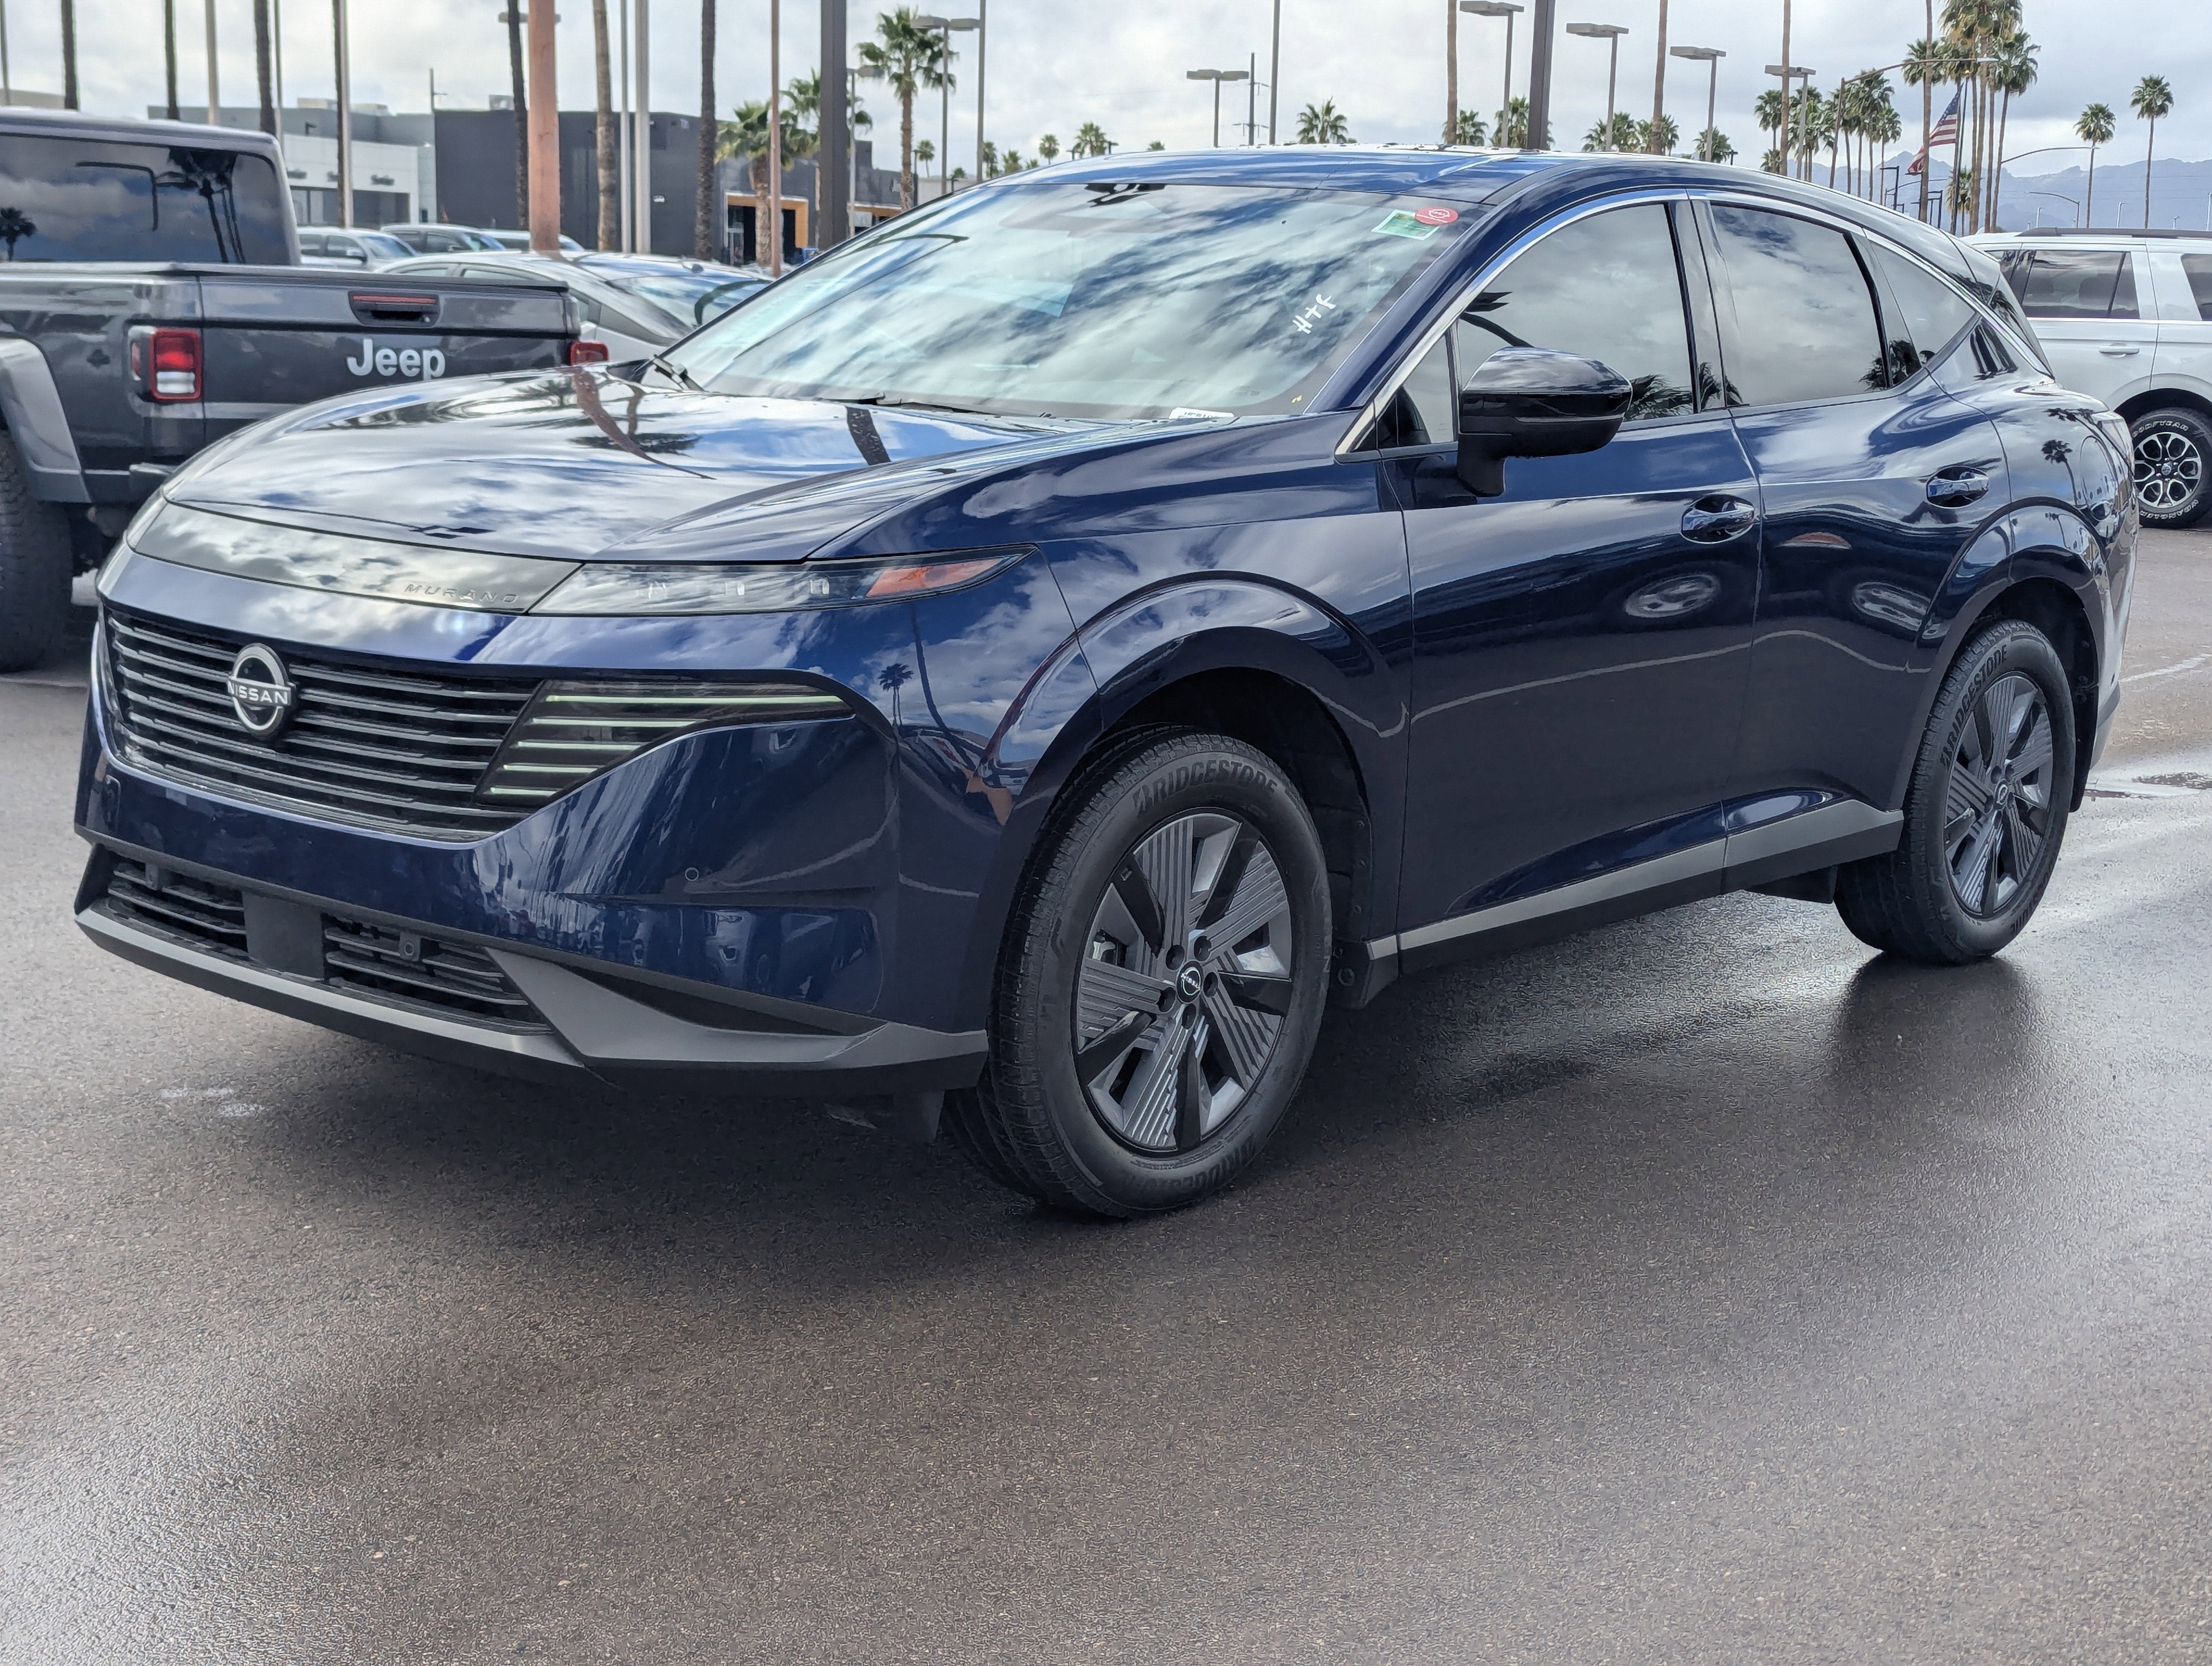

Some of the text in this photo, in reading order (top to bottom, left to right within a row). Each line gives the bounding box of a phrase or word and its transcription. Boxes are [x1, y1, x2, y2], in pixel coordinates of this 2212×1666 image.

[346, 338, 446, 380] Jeep
[404, 584, 519, 604] MURANO
[227, 680, 288, 704] NISSAN
